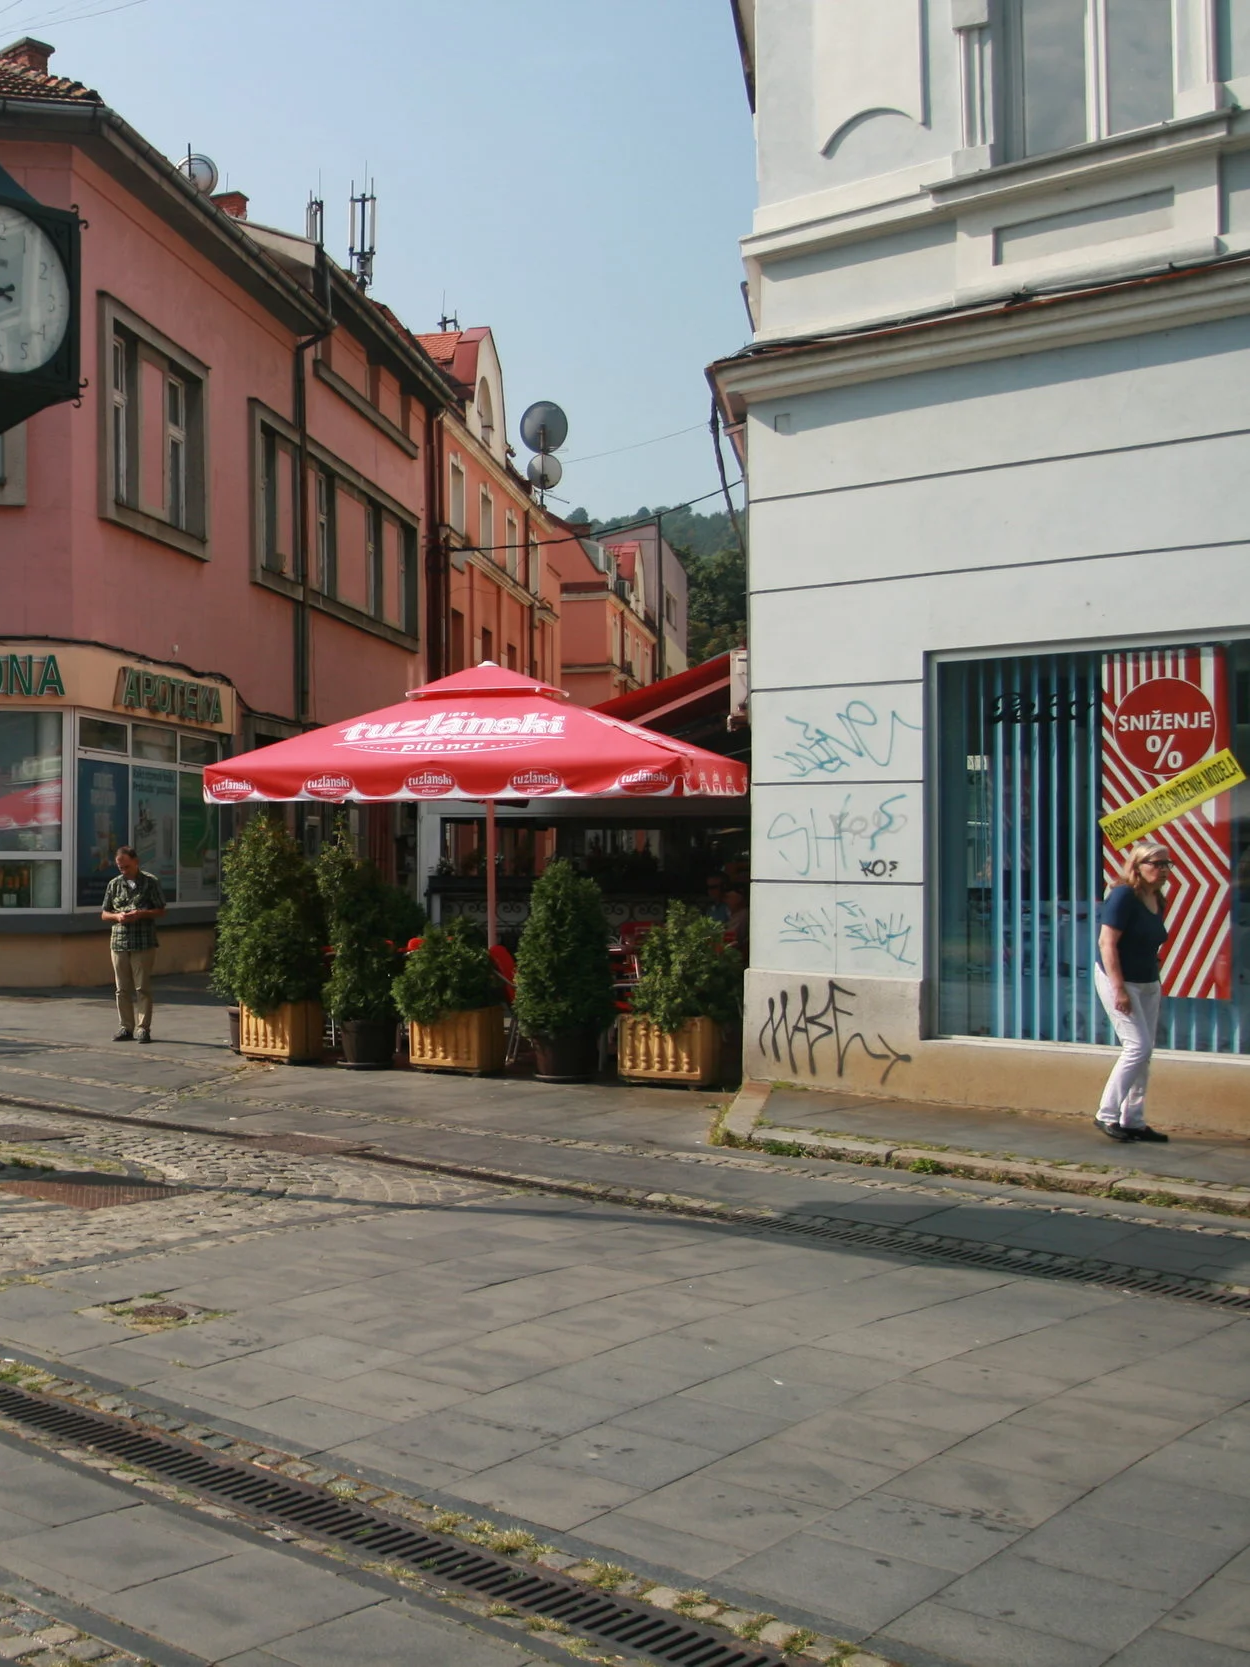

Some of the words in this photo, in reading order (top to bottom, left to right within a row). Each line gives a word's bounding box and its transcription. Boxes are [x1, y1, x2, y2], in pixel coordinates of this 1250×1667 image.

[39, 261, 48, 281] 2
[20, 341, 28, 360] 5
[121, 667, 223, 723] APOTEKA
[339, 712, 566, 741] tuzlanski
[1118, 710, 1212, 732] SNIŽENJE
[400, 741, 485, 752] pilsner
[1145, 734, 1183, 769] %
[212, 778, 252, 793] tuzlanski
[307, 775, 350, 789] tuzlanski
[408, 771, 452, 786] tuzlanski
[513, 770, 559, 786] tuzlanski
[1103, 802, 1158, 843] RASPRODAJA
[1200, 756, 1240, 788] MODELA
